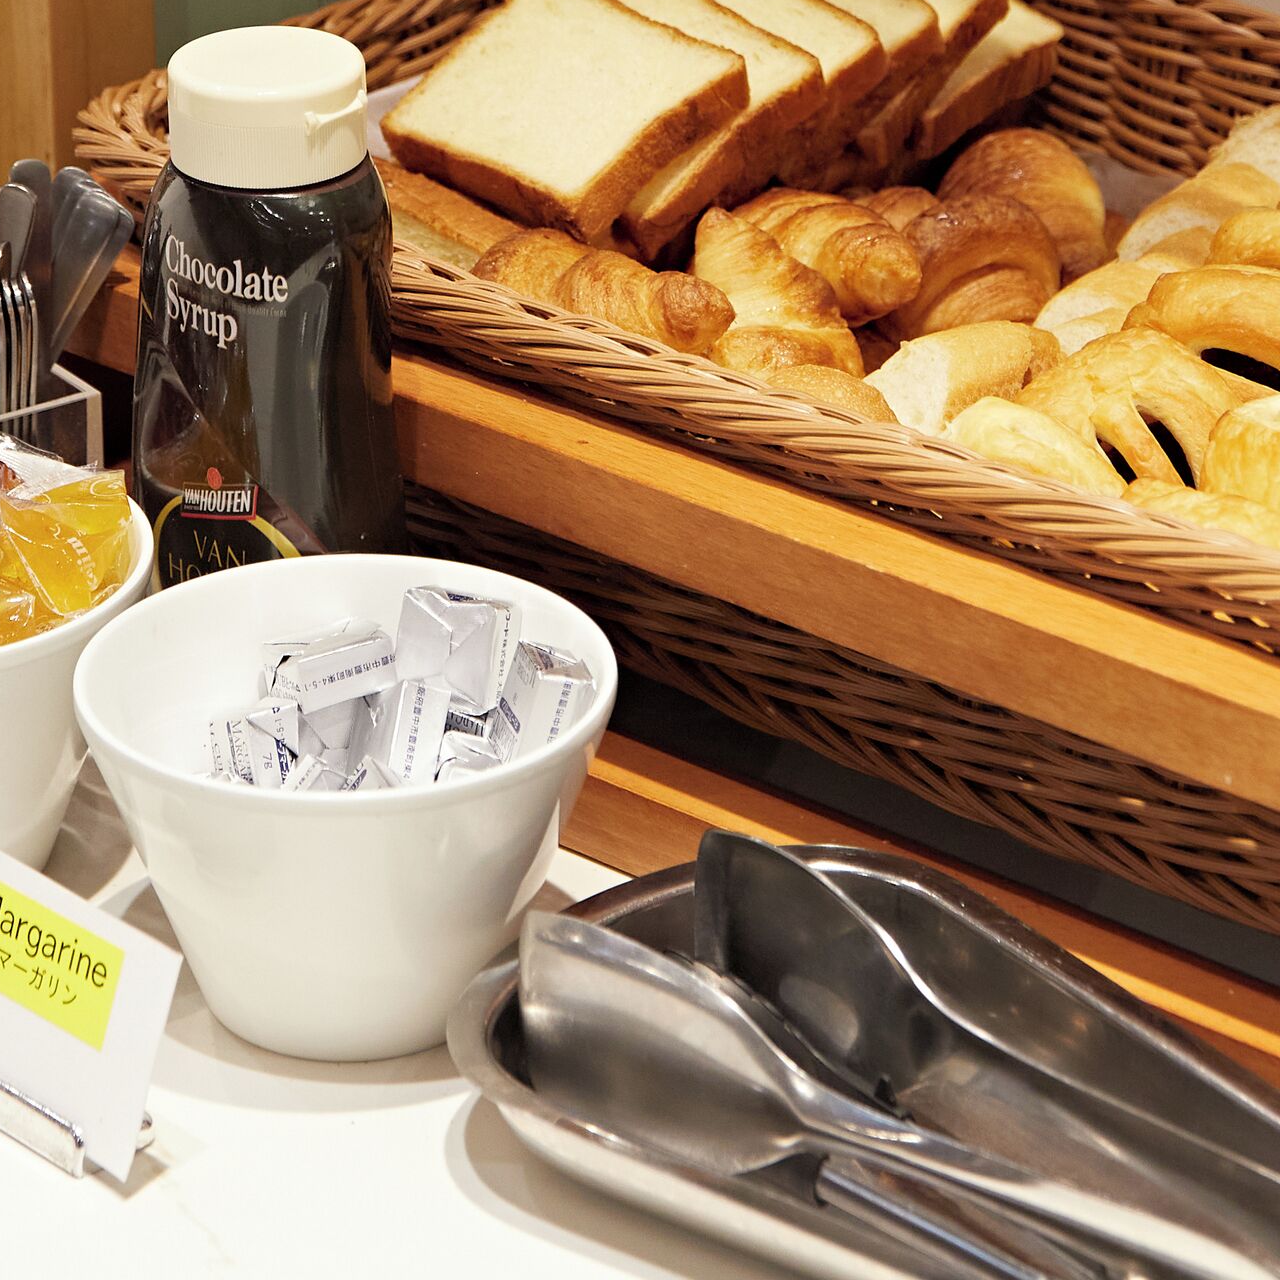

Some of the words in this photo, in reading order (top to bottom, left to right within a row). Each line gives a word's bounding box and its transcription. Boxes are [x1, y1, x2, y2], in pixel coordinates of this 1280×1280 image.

[165, 234, 289, 303] Chocolate
[166, 277, 238, 350] Syrup
[199, 489, 252, 513] HOUTEN
[193, 529, 246, 569] VAN
